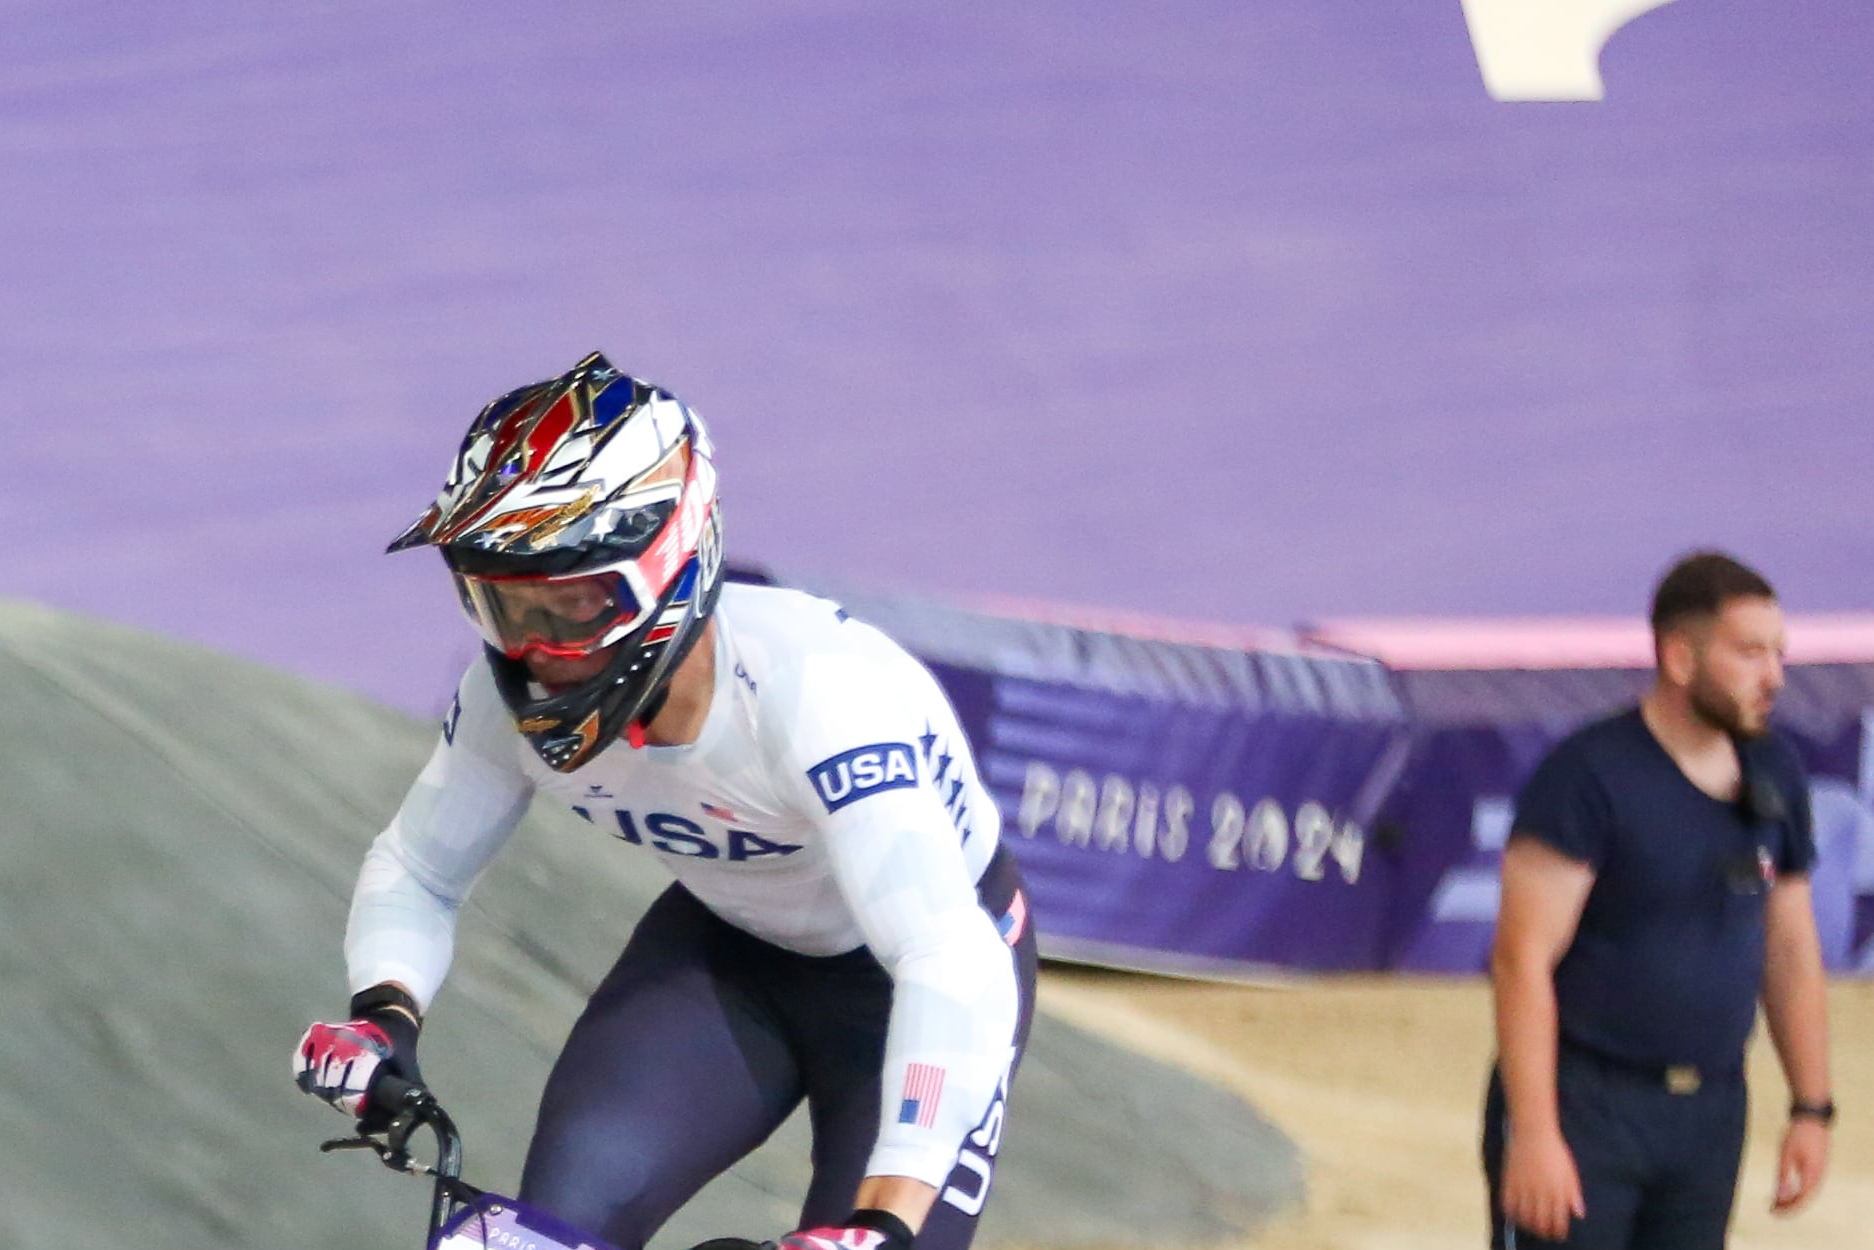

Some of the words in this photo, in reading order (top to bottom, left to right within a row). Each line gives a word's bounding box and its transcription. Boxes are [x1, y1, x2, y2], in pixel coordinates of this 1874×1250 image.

[819, 750, 916, 802] USA
[1018, 761, 1194, 863] PARIS
[1207, 790, 1364, 886] 2024
[942, 1072, 1010, 1216] US
